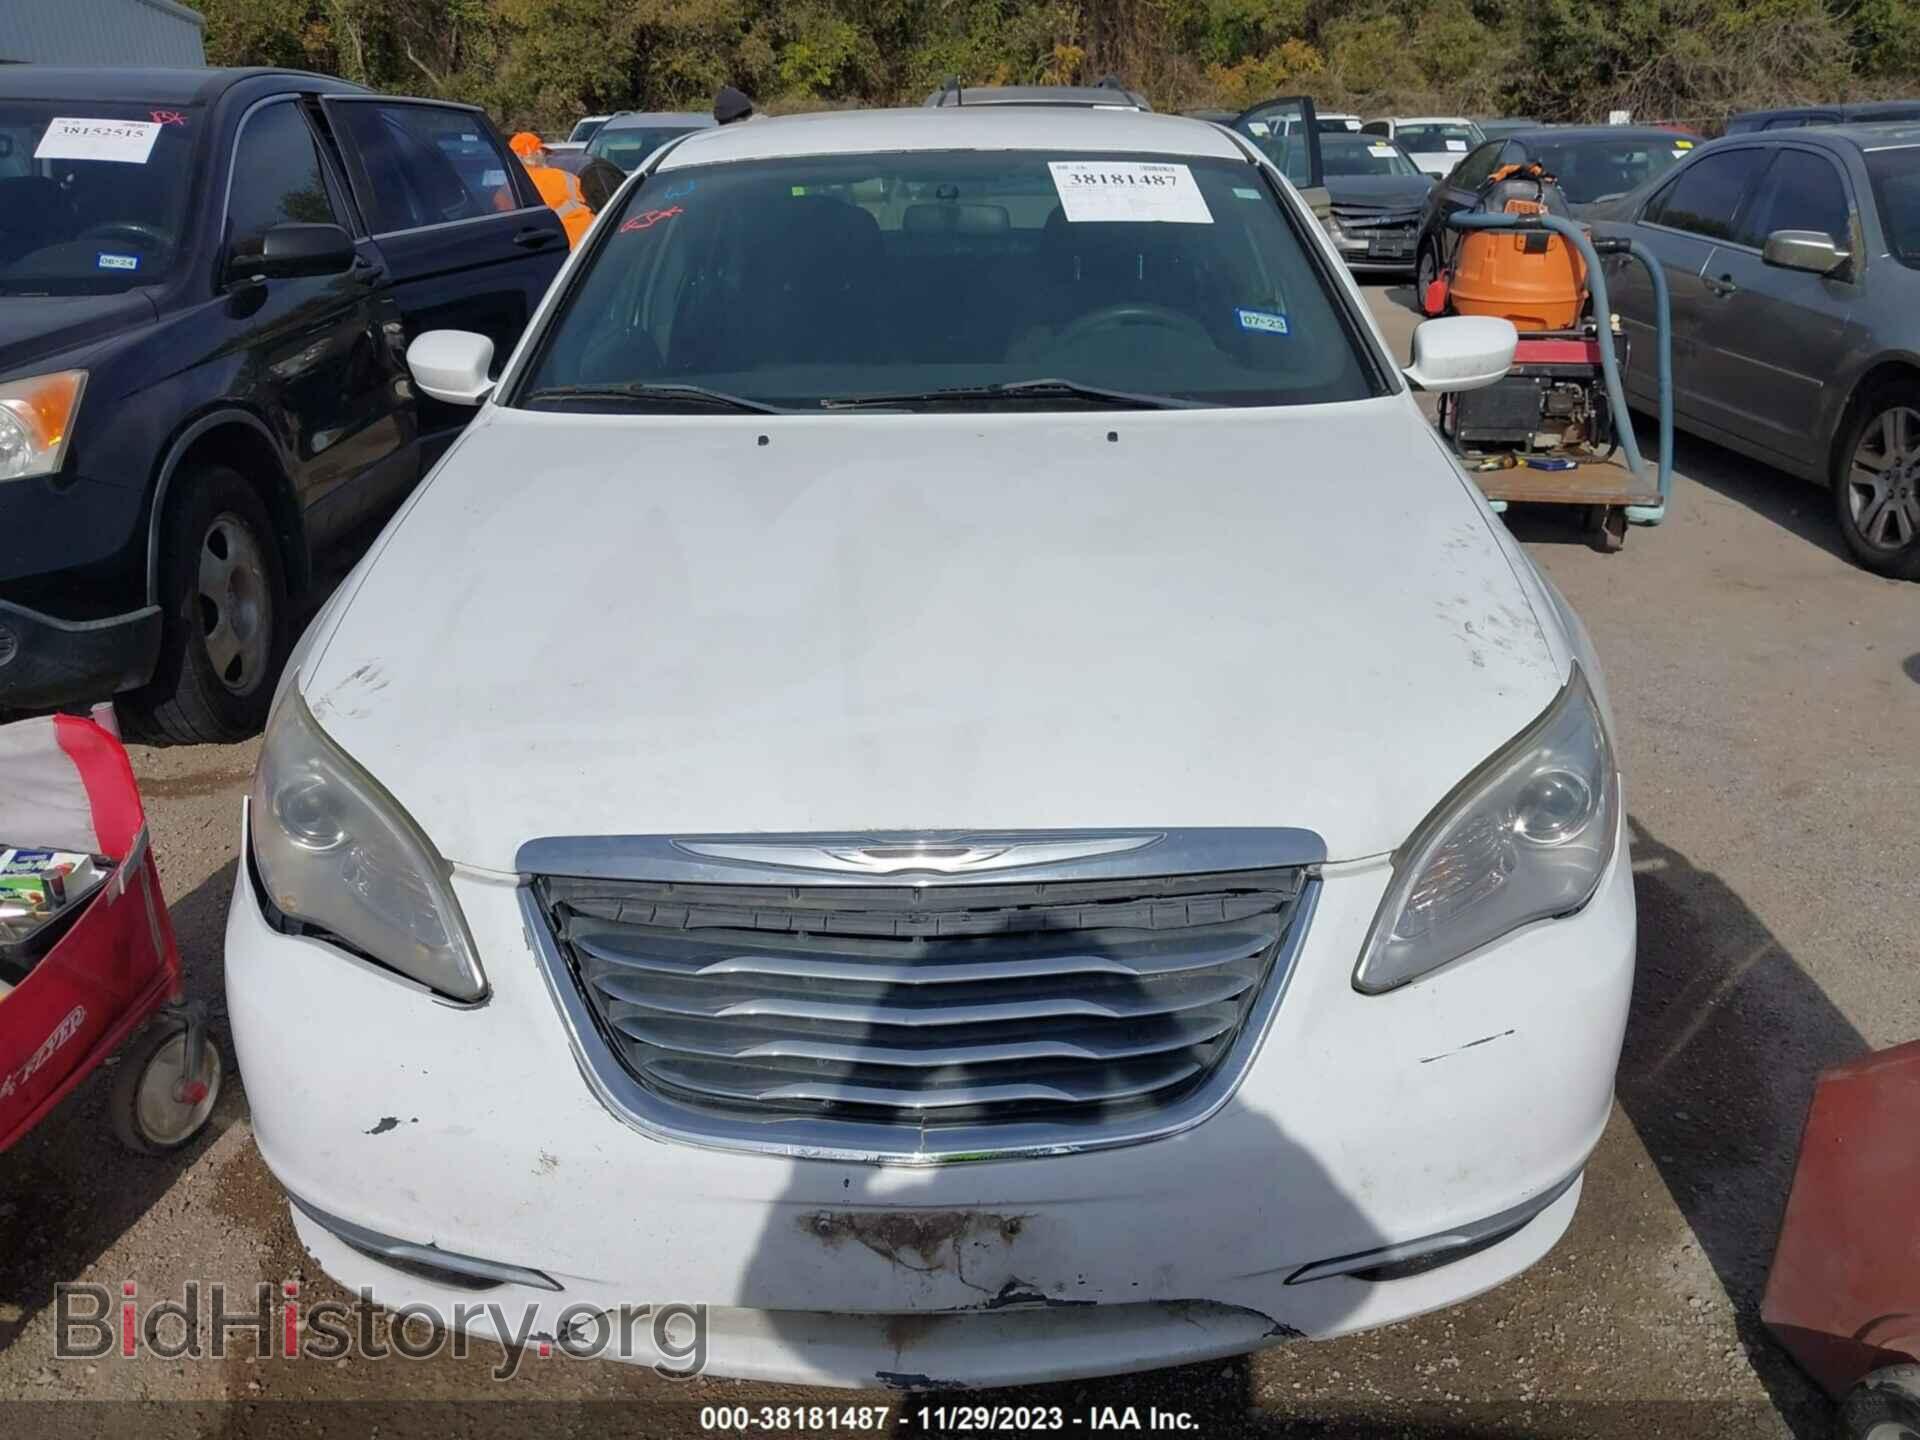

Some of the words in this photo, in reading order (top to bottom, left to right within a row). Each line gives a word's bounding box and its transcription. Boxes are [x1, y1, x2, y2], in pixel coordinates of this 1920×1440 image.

[59, 126, 145, 138] 38152515
[1070, 173, 1177, 188] 38181487
[1243, 314, 1284, 330] 07-23
